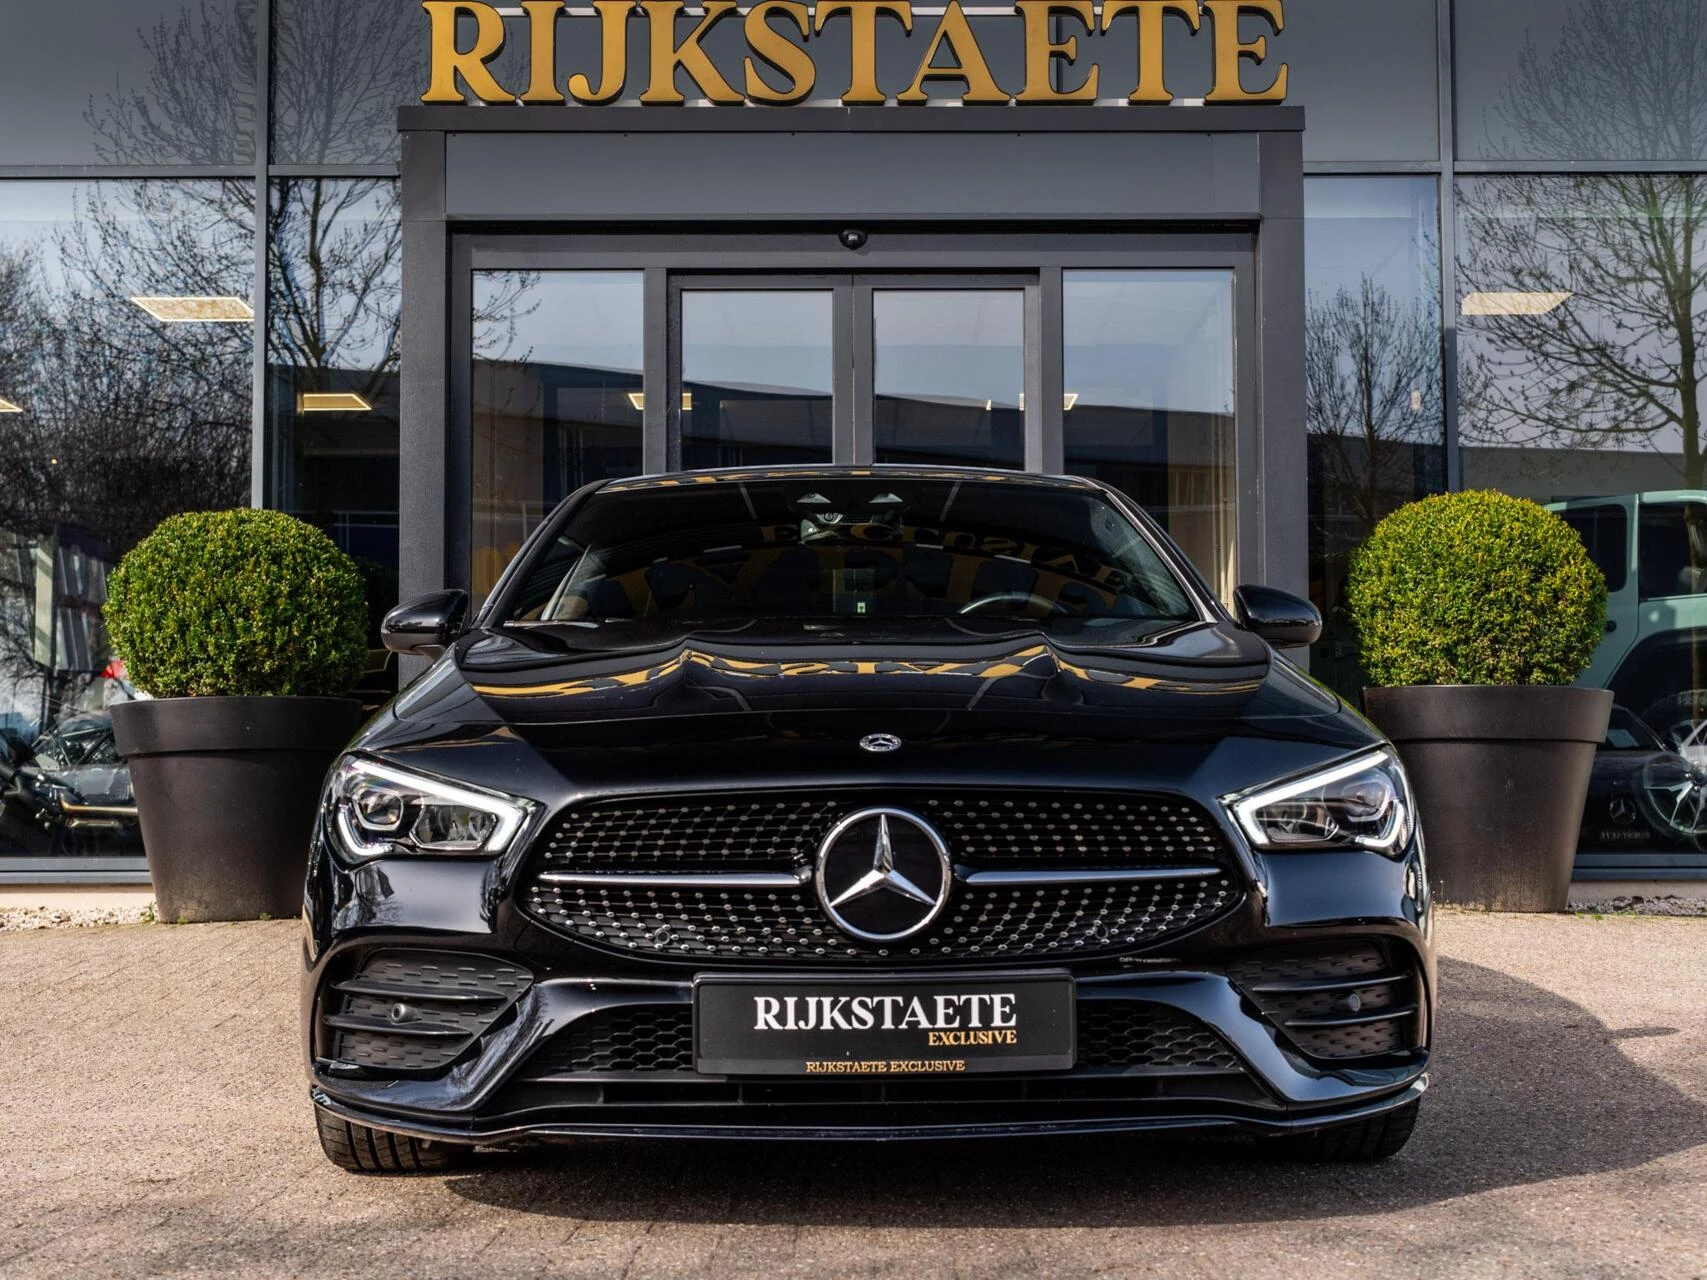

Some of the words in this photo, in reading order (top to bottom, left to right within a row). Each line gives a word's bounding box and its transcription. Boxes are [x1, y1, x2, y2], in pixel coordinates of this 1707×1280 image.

[420, 0, 1288, 106] RIJKSTAETE
[754, 994, 1016, 1030] RIJKSTAETE
[928, 1031, 1017, 1046] EXCLUSIVE
[806, 1061, 887, 1073] RIJKSTAETE
[891, 1060, 965, 1072] EXCLUSIVE
